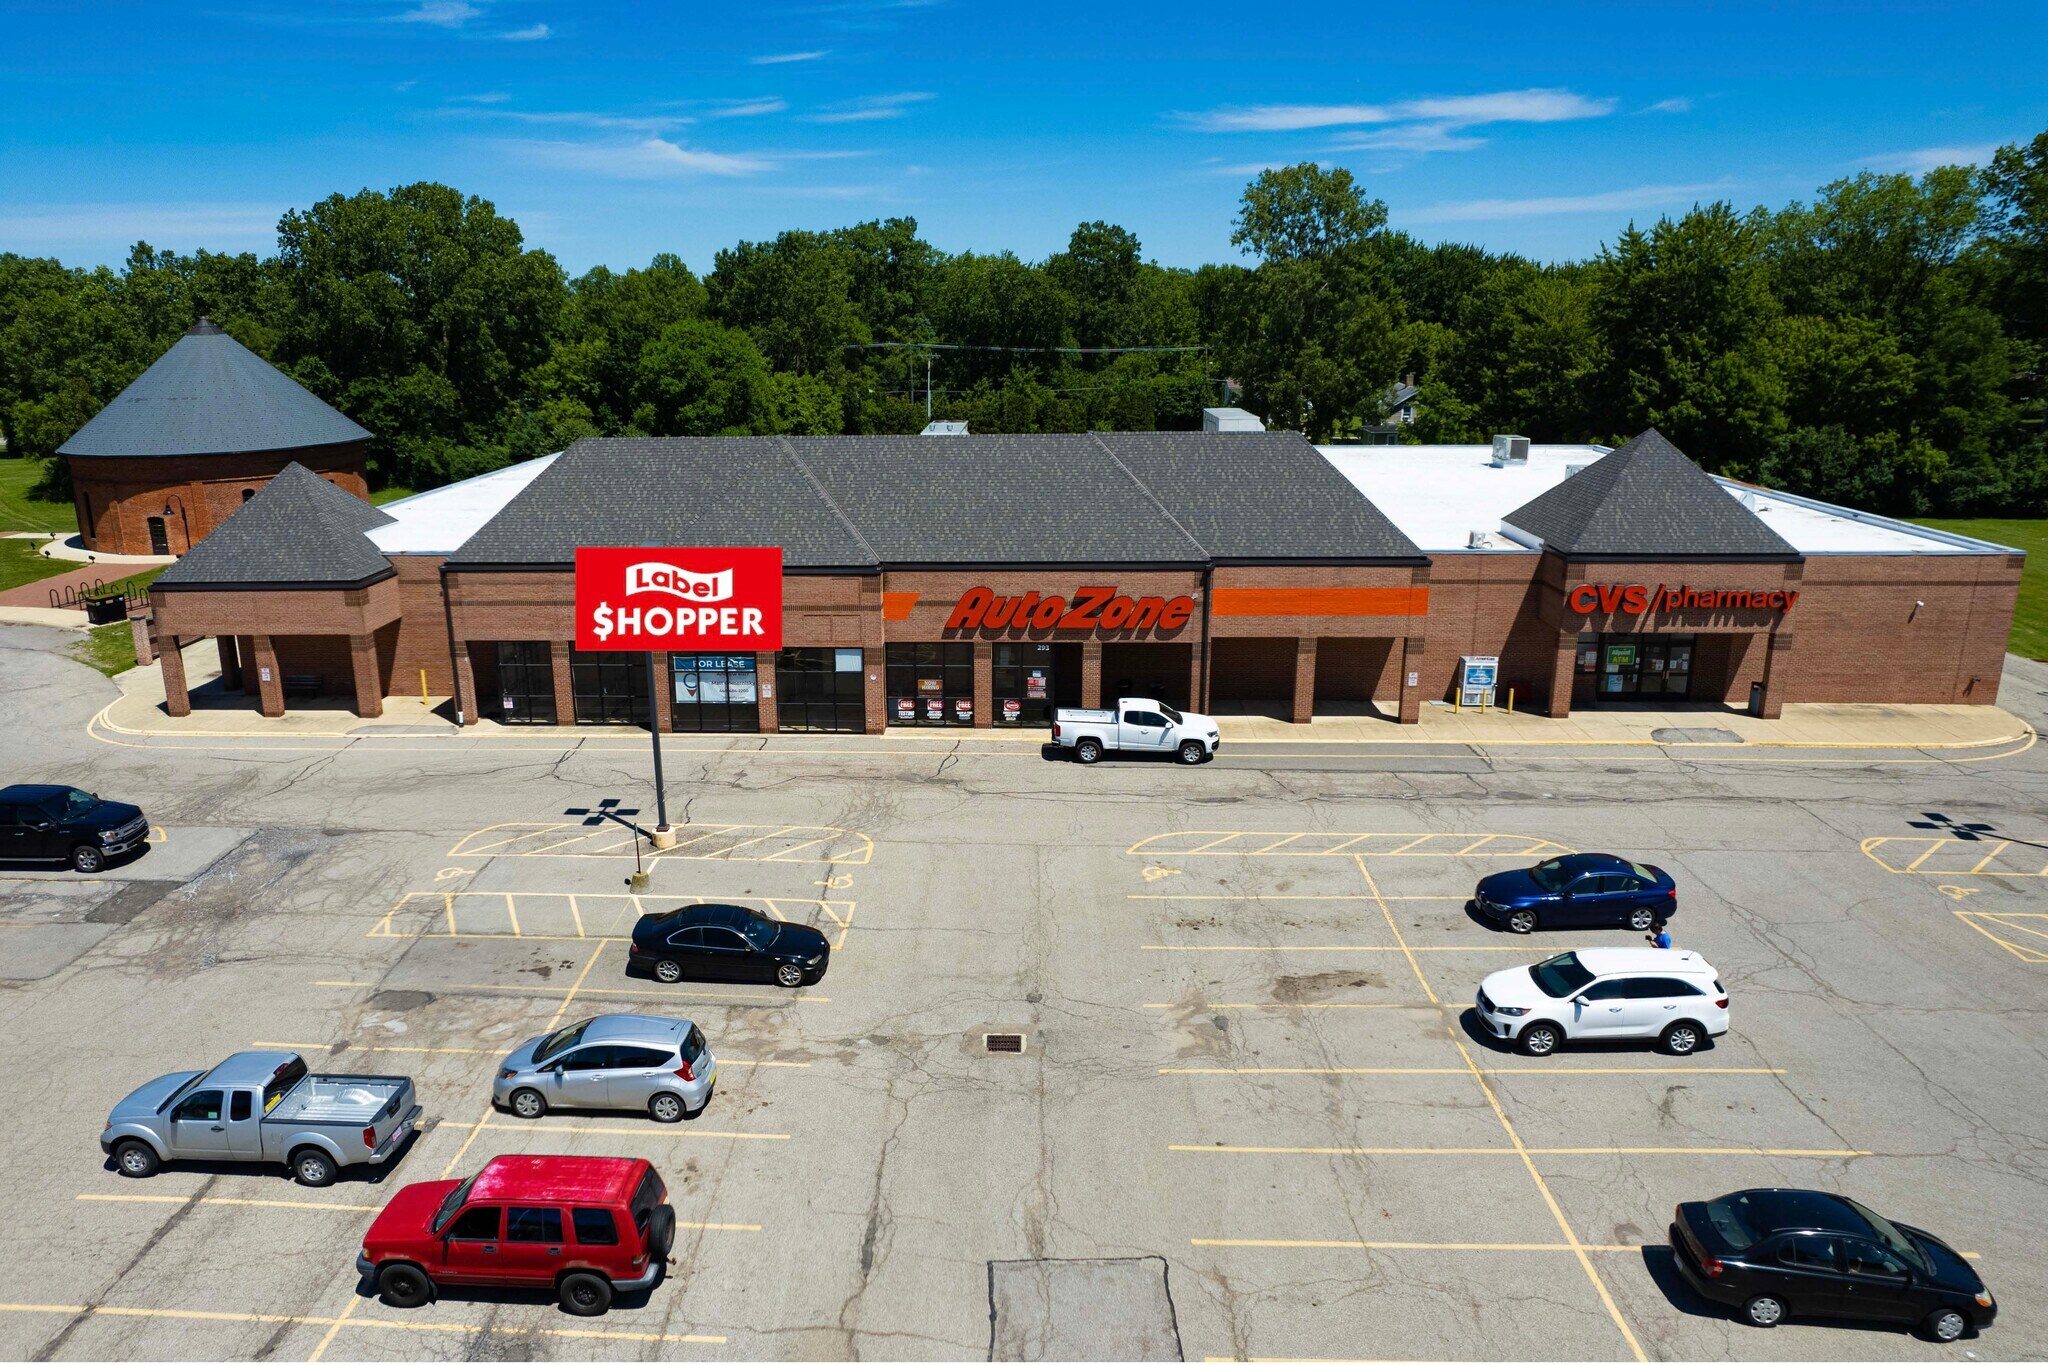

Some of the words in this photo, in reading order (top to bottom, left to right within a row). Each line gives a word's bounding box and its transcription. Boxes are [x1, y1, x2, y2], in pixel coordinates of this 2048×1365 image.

[636, 568, 718, 597] Label
[593, 601, 765, 642] $HOPPER
[945, 586, 1195, 630] AutoZone
[715, 660, 745, 669] LEASE
